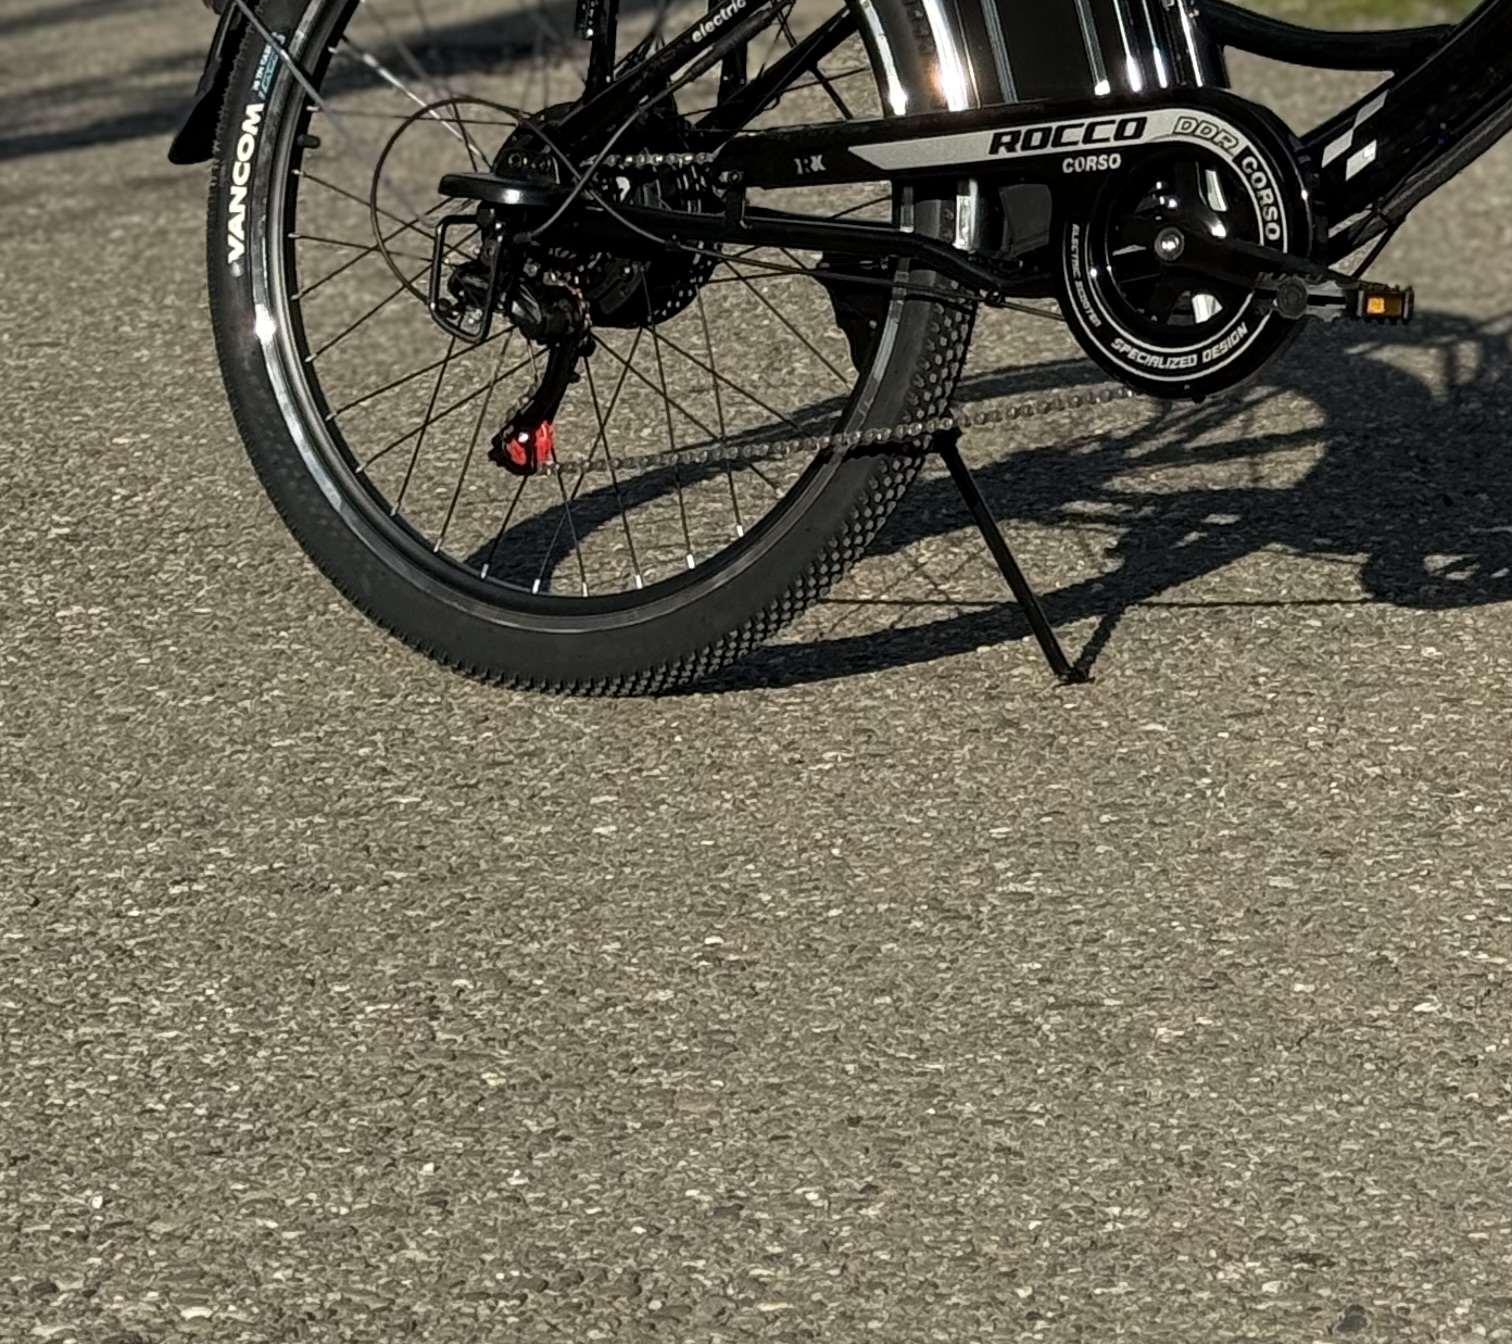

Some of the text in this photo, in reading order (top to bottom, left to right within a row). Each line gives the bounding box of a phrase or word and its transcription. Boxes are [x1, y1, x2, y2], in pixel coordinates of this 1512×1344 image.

[228, 102, 265, 264] VANCOM
[988, 116, 1281, 241] ROCCO DDR CORSO
[1062, 153, 1122, 173] CORSO
[1111, 322, 1248, 370] SPECIALIZED DESIGN
